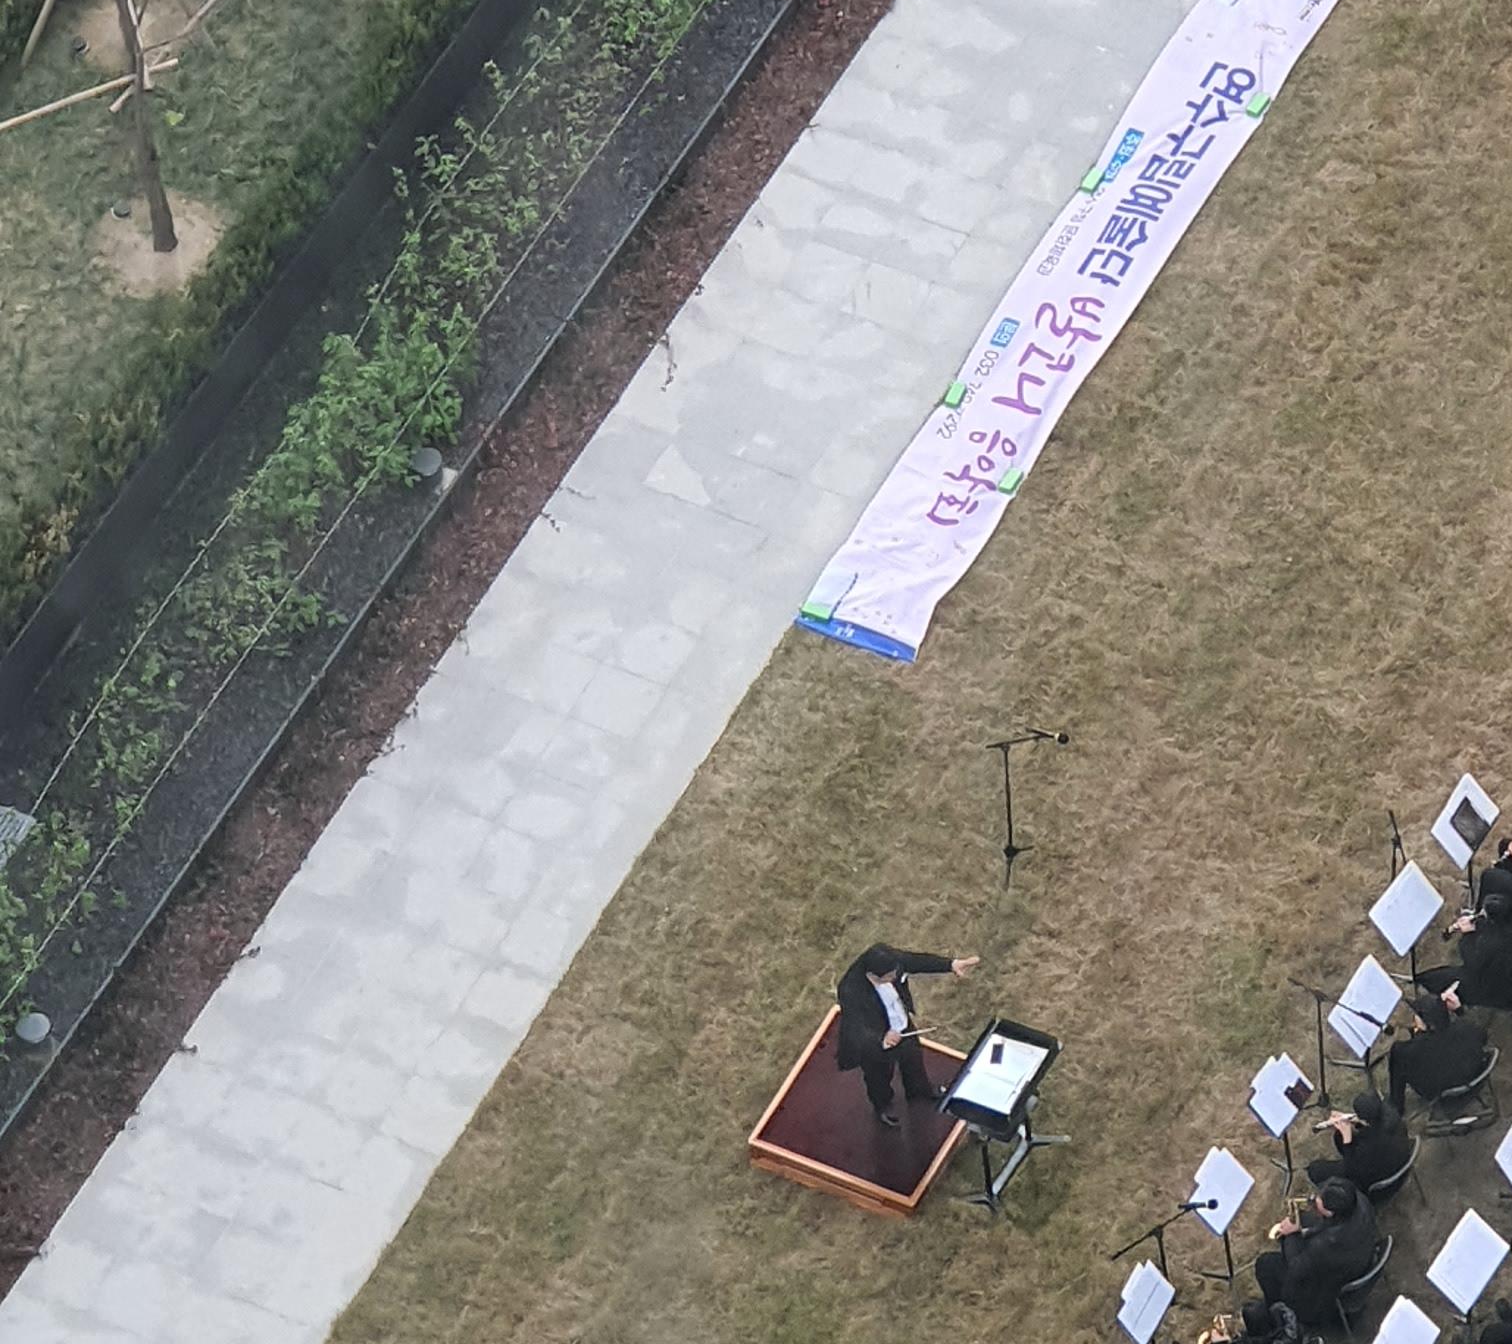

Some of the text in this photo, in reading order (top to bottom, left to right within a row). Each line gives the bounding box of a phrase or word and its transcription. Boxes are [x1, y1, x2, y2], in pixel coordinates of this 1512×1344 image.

[926, 61, 1256, 526] 연수구립예술단 발코니 음악회
[974, 349, 999, 376] 032
